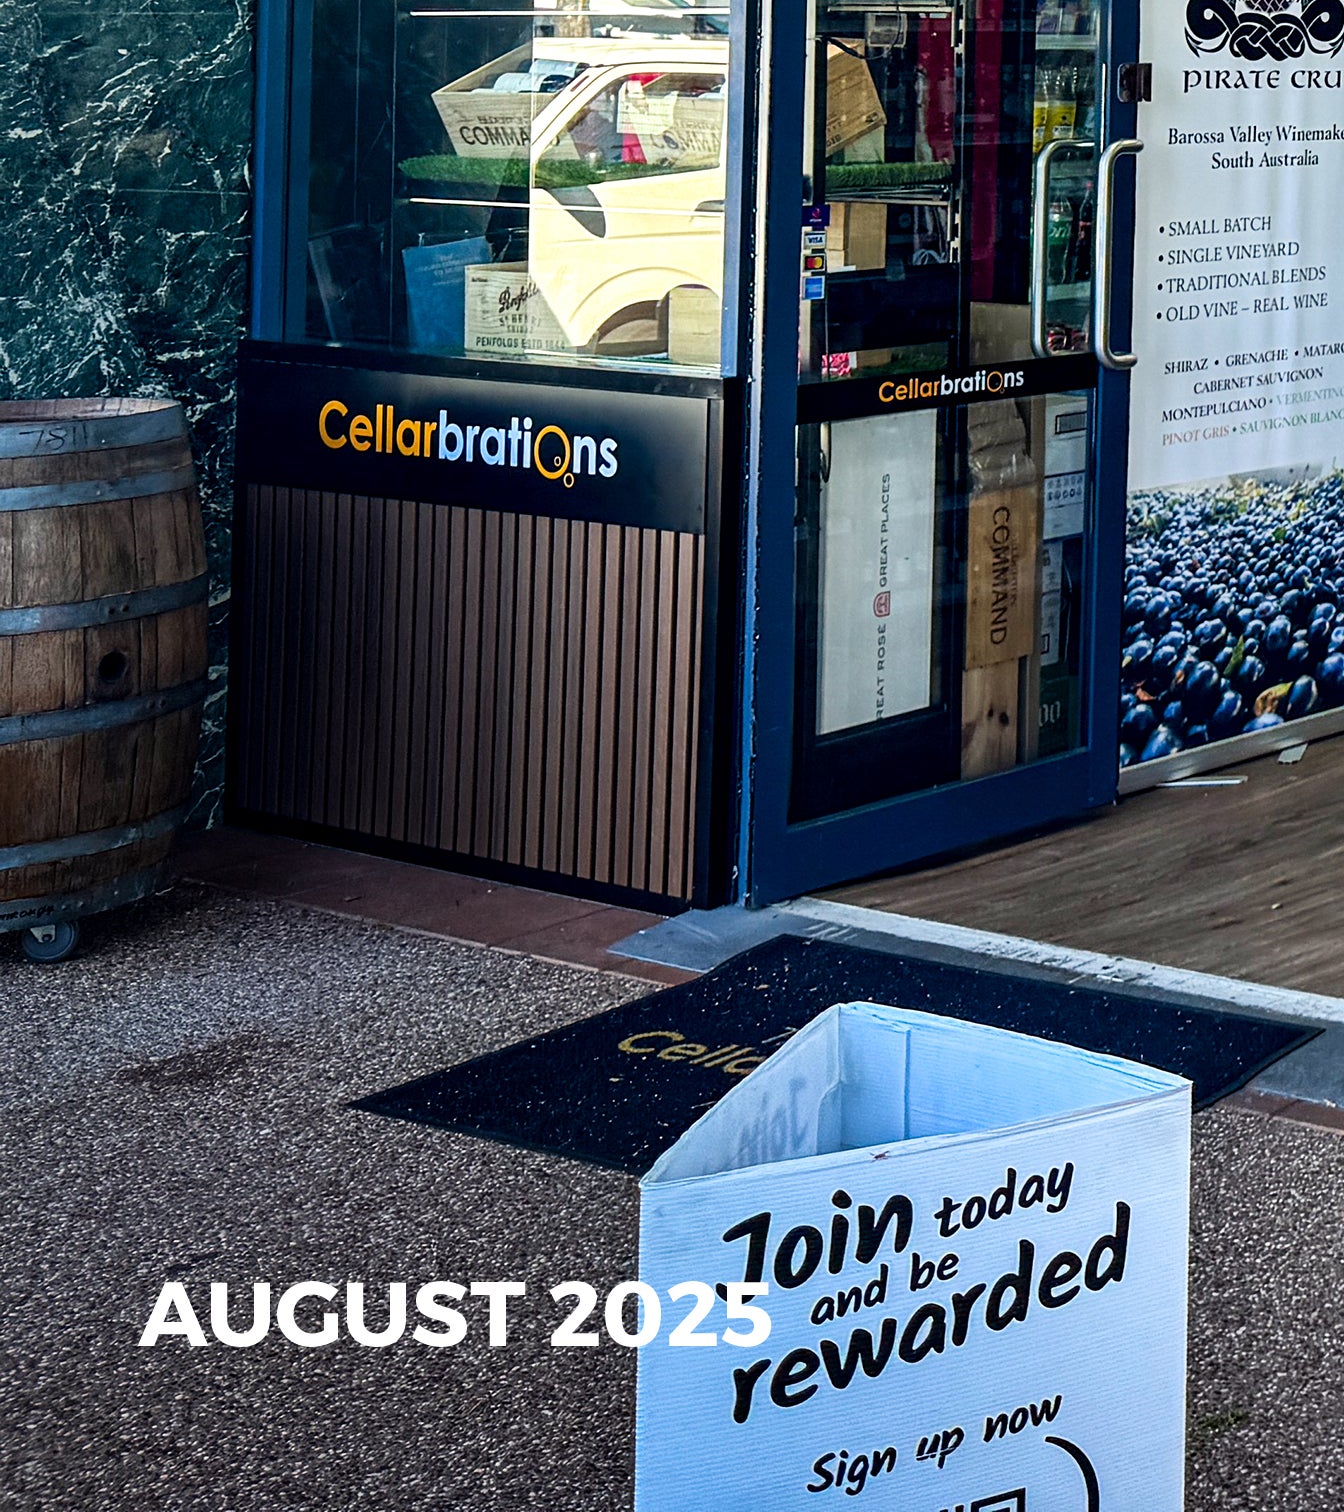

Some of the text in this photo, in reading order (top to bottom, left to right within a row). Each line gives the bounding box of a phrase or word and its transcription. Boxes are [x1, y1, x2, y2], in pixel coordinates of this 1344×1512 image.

[1183, 68, 1343, 93] PIRATE CRU
[1168, 127, 1225, 146] Barossa
[1230, 126, 1272, 147] Valley
[1211, 151, 1319, 170] South Australia
[1168, 216, 1272, 237] SMALL BATCH
[1167, 242, 1300, 265] SINGLE VINEYARD
[1166, 266, 1327, 294] TRADITIONAL BLENDS
[1166, 293, 1328, 322] OLD VINE REAL WINE
[1164, 358, 1208, 375] SHIRAZ
[1225, 349, 1289, 368] GRENACHE
[878, 368, 1024, 402] Cellarbrations
[1193, 367, 1324, 395] CABERNET SAUVIGNON
[1162, 396, 1267, 423] MONTEPULCIANO
[319, 400, 618, 487] Cellarbrations
[1162, 428, 1200, 446] PINOT
[1202, 425, 1230, 442] GRIS
[1239, 415, 1308, 436] SAUVIGNON
[881, 473, 890, 535] PLACES
[879, 537, 889, 588] GREAT
[990, 506, 1010, 645] COMMAND
[715, 1160, 1074, 1303] Join today
[809, 1251, 960, 1326] and be
[730, 1203, 1131, 1425] rewarded
[807, 1394, 1062, 1496] Sign up now
